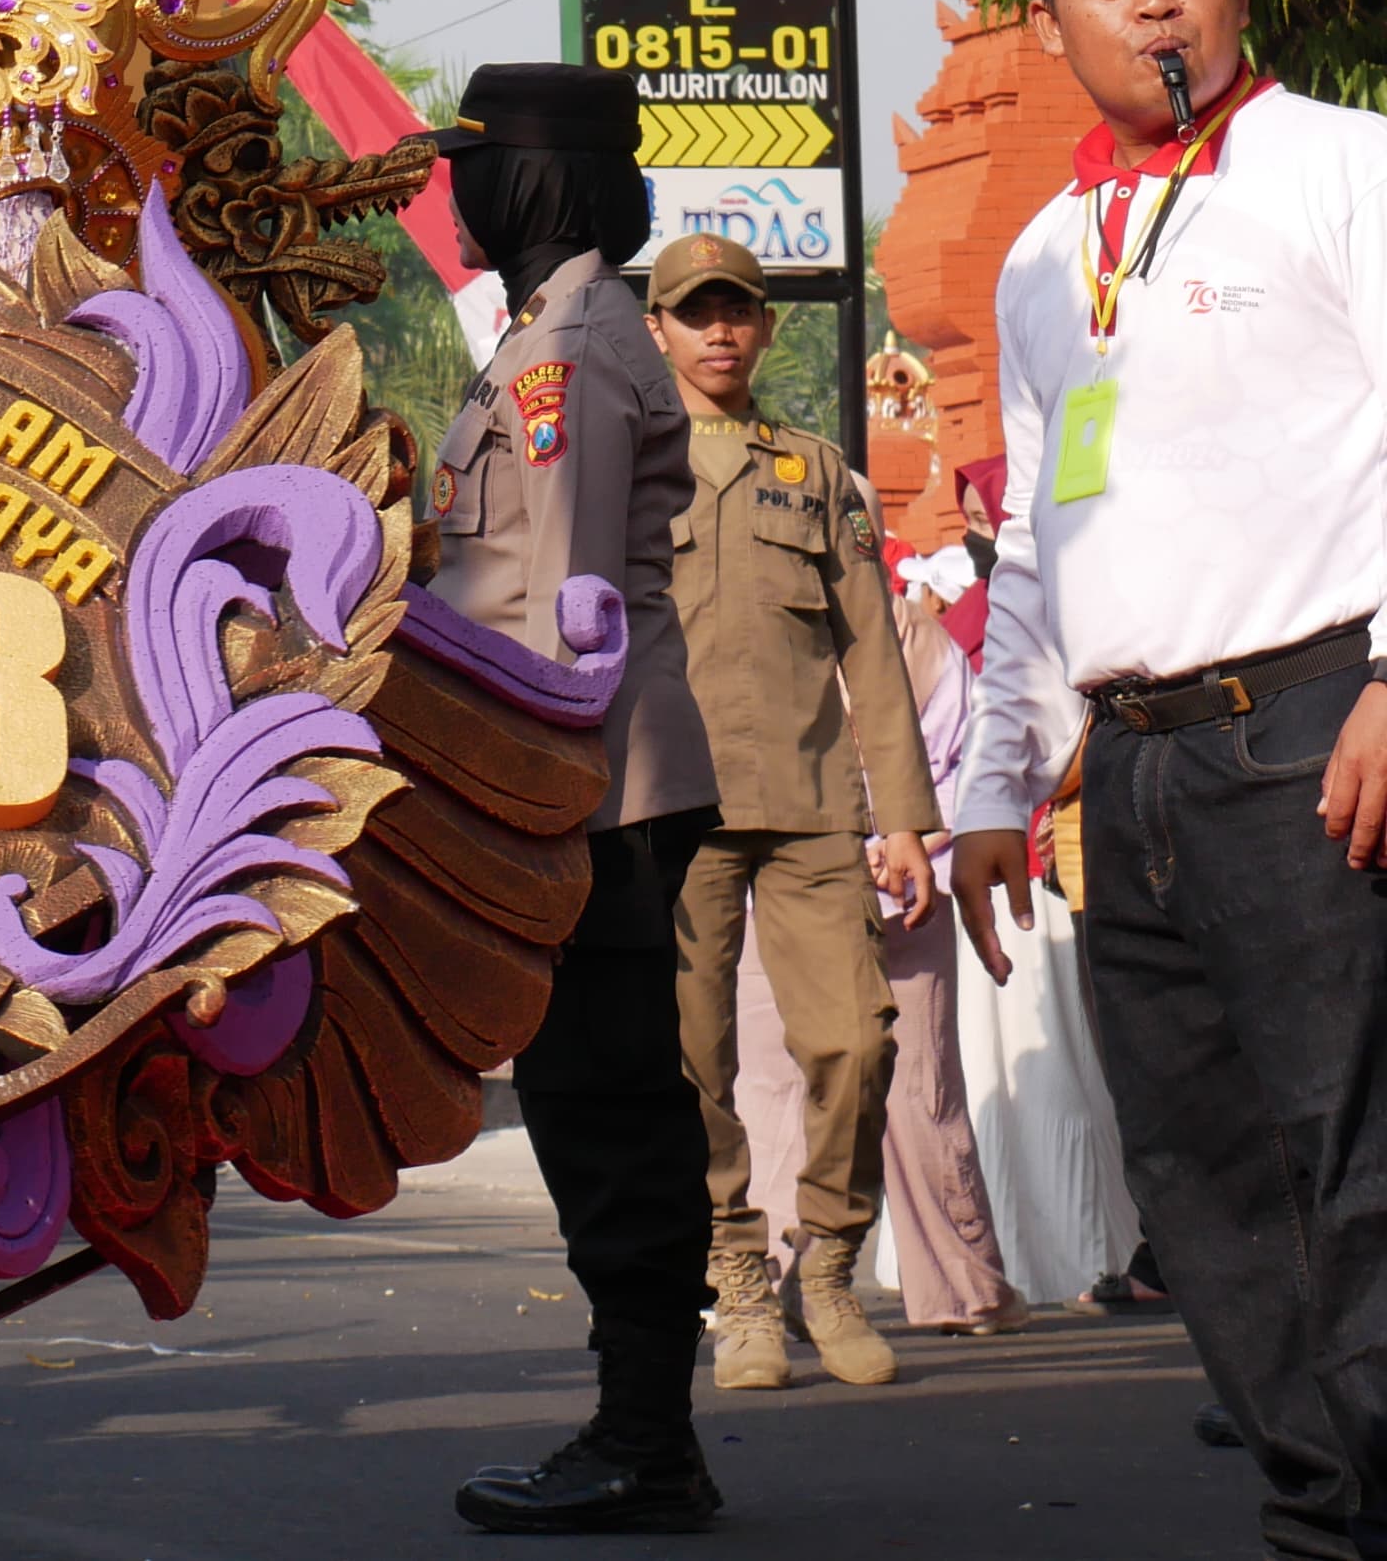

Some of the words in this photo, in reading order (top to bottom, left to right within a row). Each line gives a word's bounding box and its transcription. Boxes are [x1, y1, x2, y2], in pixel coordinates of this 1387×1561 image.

[595, 24, 829, 70] 0815-01
[636, 73, 732, 100] AJURIT
[736, 73, 828, 100] KULON
[515, 364, 564, 392] POLRES
[755, 487, 792, 508] POL
